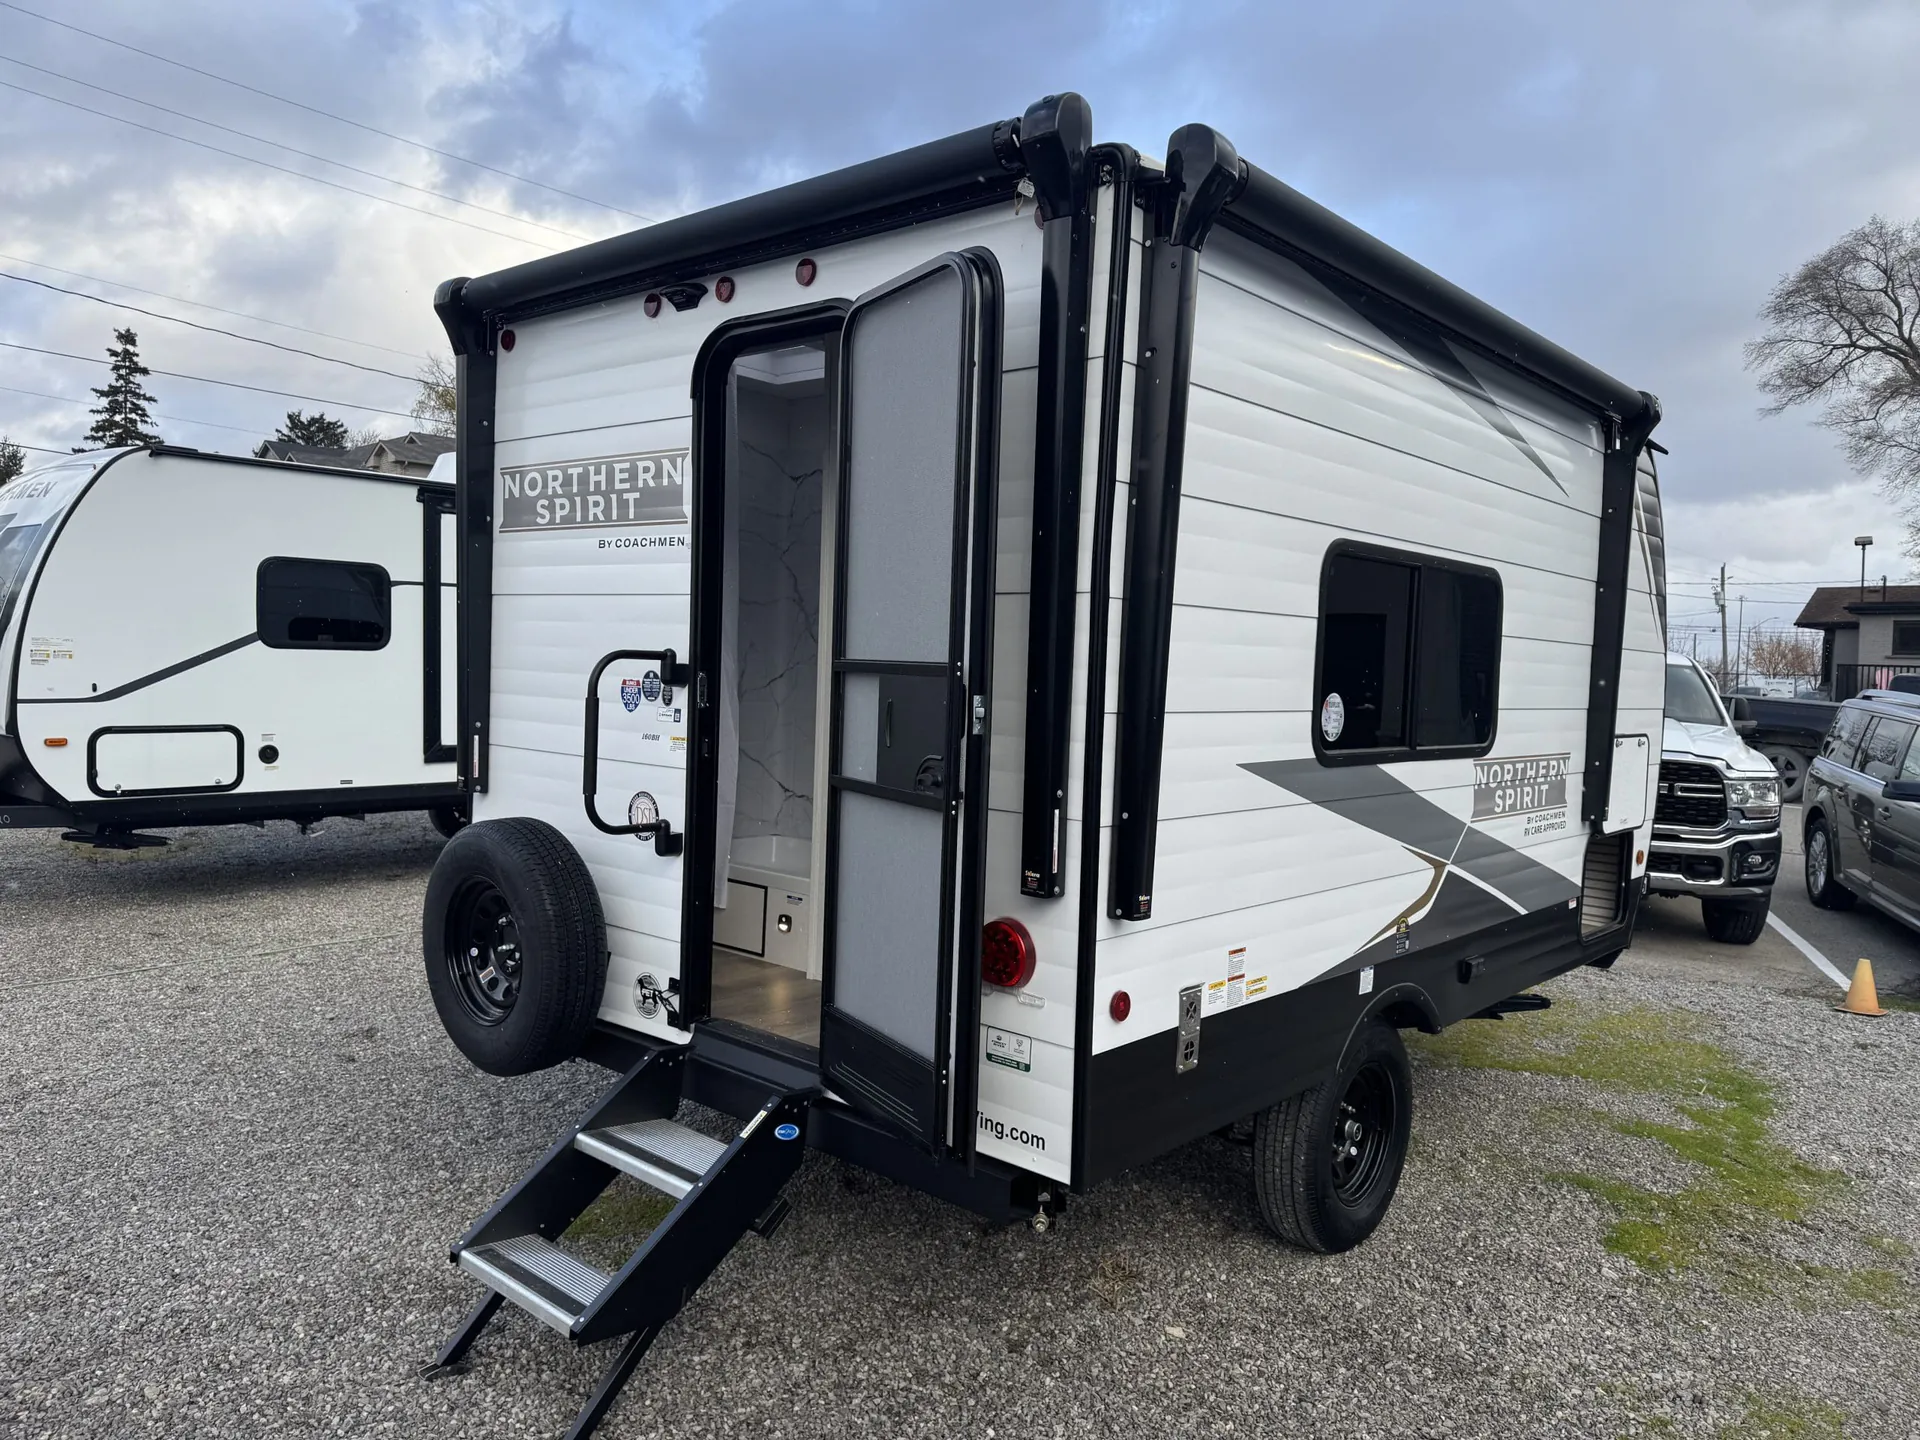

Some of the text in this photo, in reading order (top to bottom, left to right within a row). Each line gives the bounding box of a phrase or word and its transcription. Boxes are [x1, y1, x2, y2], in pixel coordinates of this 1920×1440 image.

[503, 457, 683, 499] NORTHERN
[536, 492, 640, 525] SPIRIT
[598, 537, 685, 549] BY COACHMEN
[622, 693, 640, 704] 3500
[1474, 759, 1568, 789] NORTHERN
[1494, 784, 1549, 813] SPIRIT
[1527, 811, 1566, 824] BY COACHMEN
[1531, 825, 1543, 835] CARE
[1543, 820, 1567, 832] APPROVED
[977, 1111, 1045, 1151] ing.com
